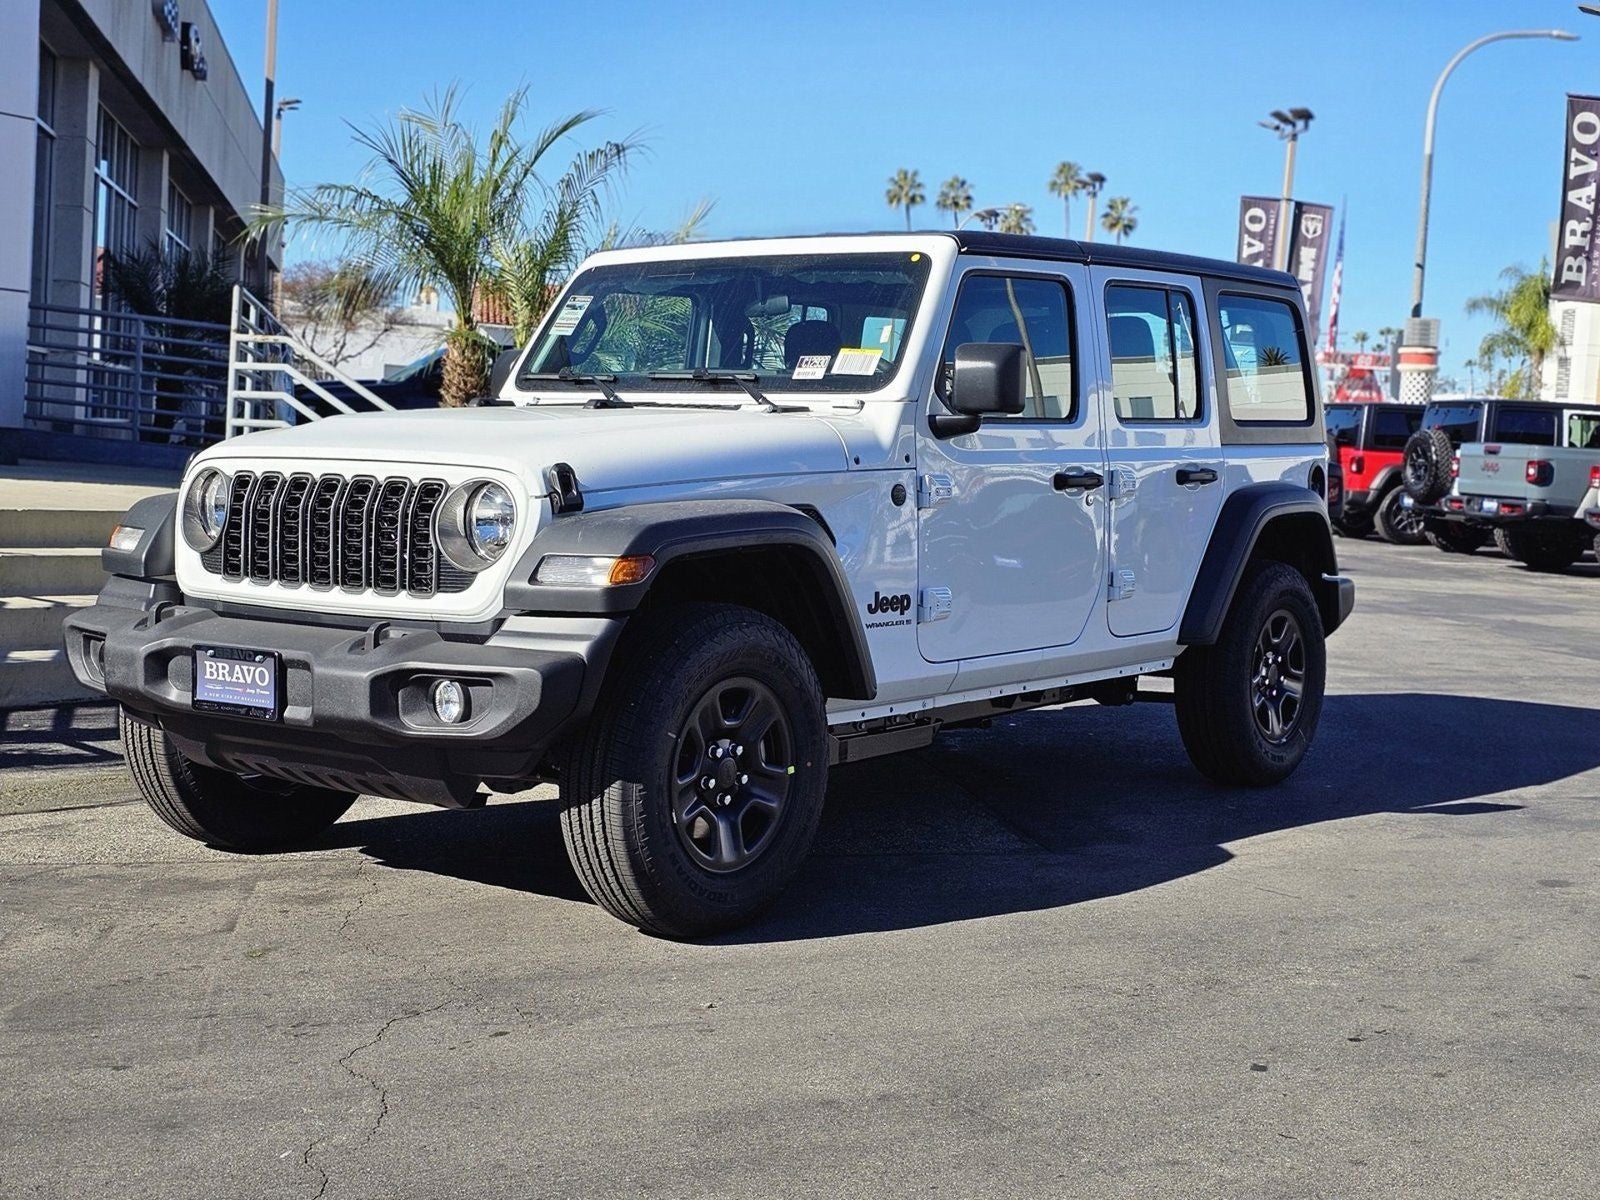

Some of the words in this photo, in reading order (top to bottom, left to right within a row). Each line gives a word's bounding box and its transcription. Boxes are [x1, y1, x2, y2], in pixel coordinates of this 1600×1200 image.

[1561, 111, 1600, 287] BRAVO
[1242, 207, 1266, 267] VO
[867, 591, 912, 615] Jeep
[865, 620, 905, 629] WRANGLER
[215, 648, 255, 661] BRAVO
[203, 660, 270, 687] BRAVO
